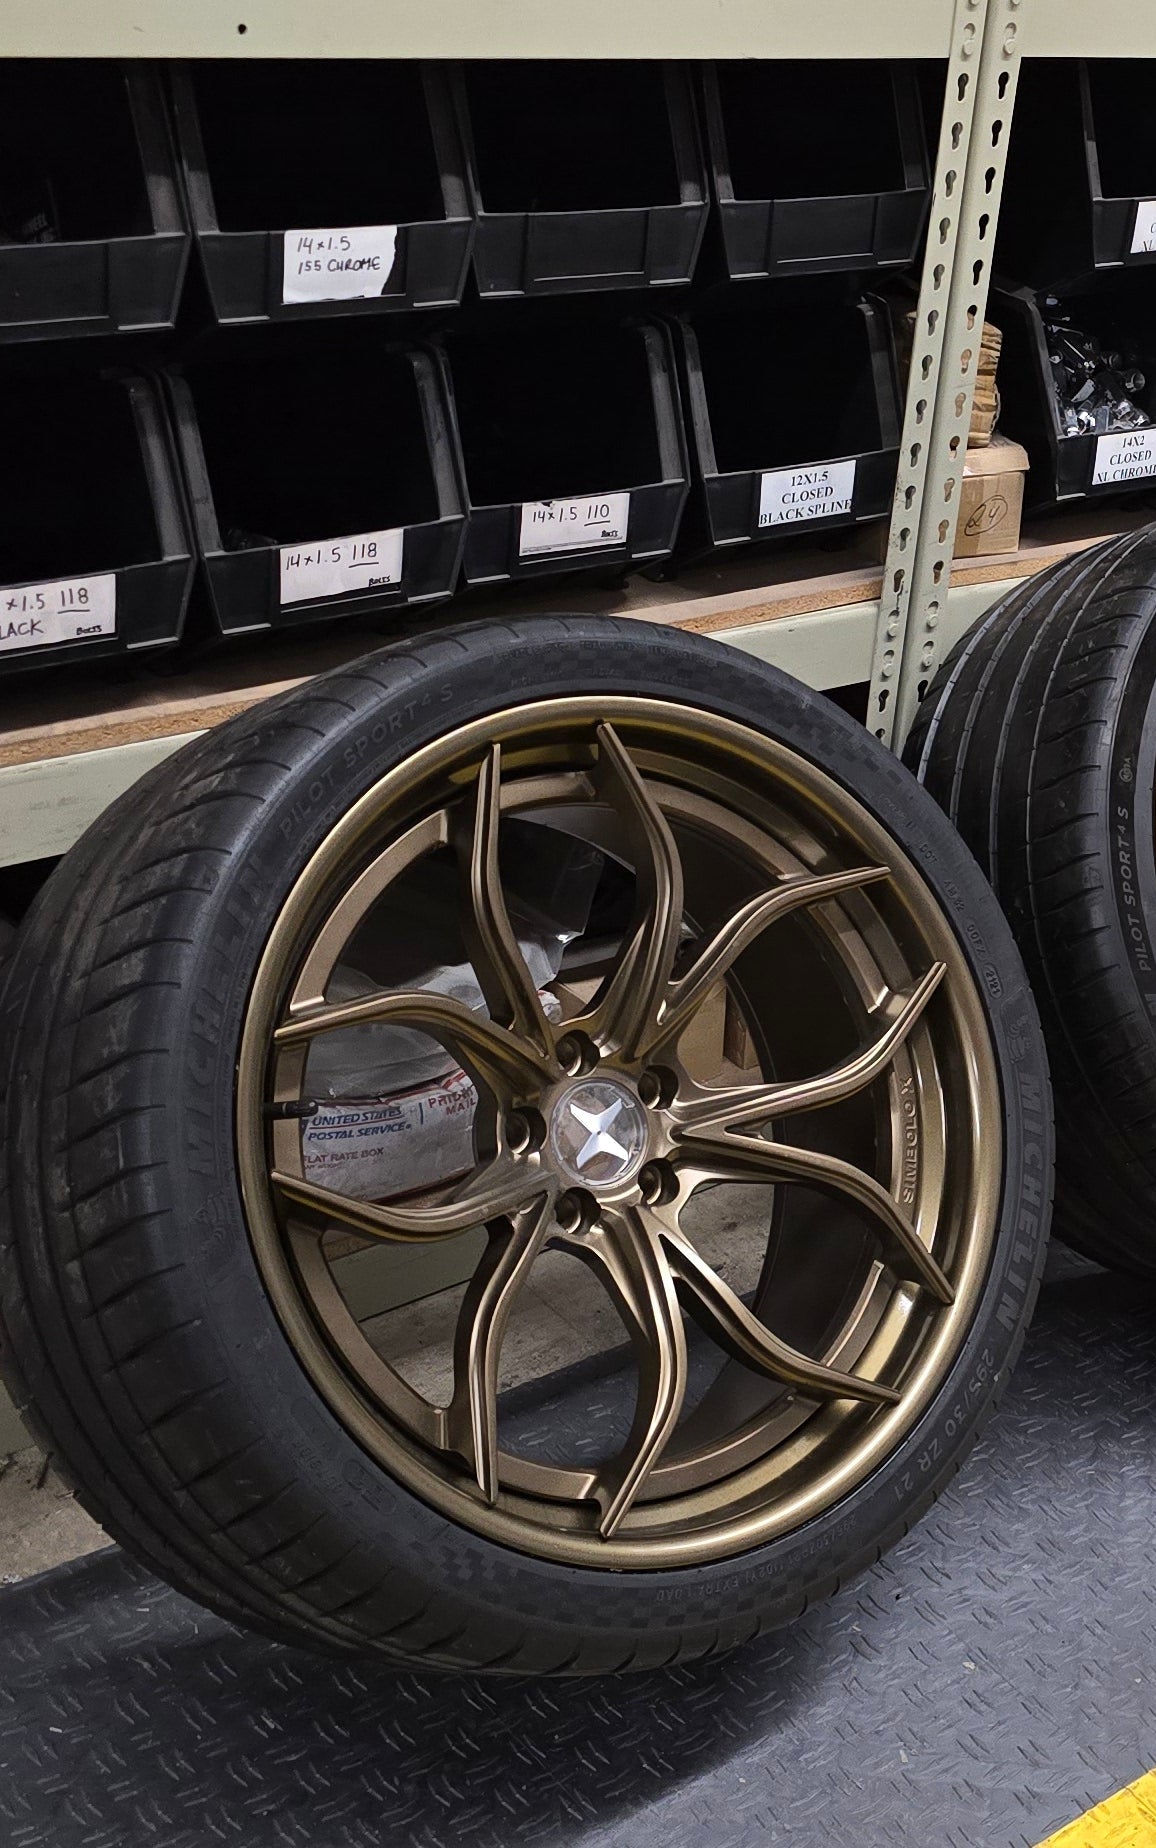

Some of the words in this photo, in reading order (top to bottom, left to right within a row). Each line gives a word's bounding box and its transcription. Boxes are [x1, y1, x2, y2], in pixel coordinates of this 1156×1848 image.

[298, 260, 321, 275] 155
[327, 256, 381, 272] CHROME
[1123, 435, 1145, 448] 14X2
[1109, 450, 1152, 466] CLOSED
[791, 470, 829, 487] 12X1.5
[1096, 471, 1110, 483] XL
[781, 486, 834, 504] CLOSED
[587, 503, 610, 520] 110
[760, 507, 805, 524] BLACK
[352, 542, 377, 561] 118
[60, 587, 89, 608] 118
[279, 771, 342, 840] PILOT
[343, 701, 420, 769] SPORT
[1117, 806, 1129, 820] S
[1117, 836, 1137, 907] SPORT
[1127, 913, 1153, 972] PILOT
[445, 1099, 476, 1116] MAIL
[312, 1112, 360, 1126] UNITED
[308, 1130, 355, 1141] POSTAL
[330, 1149, 359, 1162] RATE
[360, 1147, 384, 1160] BOX
[995, 1071, 1044, 1333] MICHELIN
